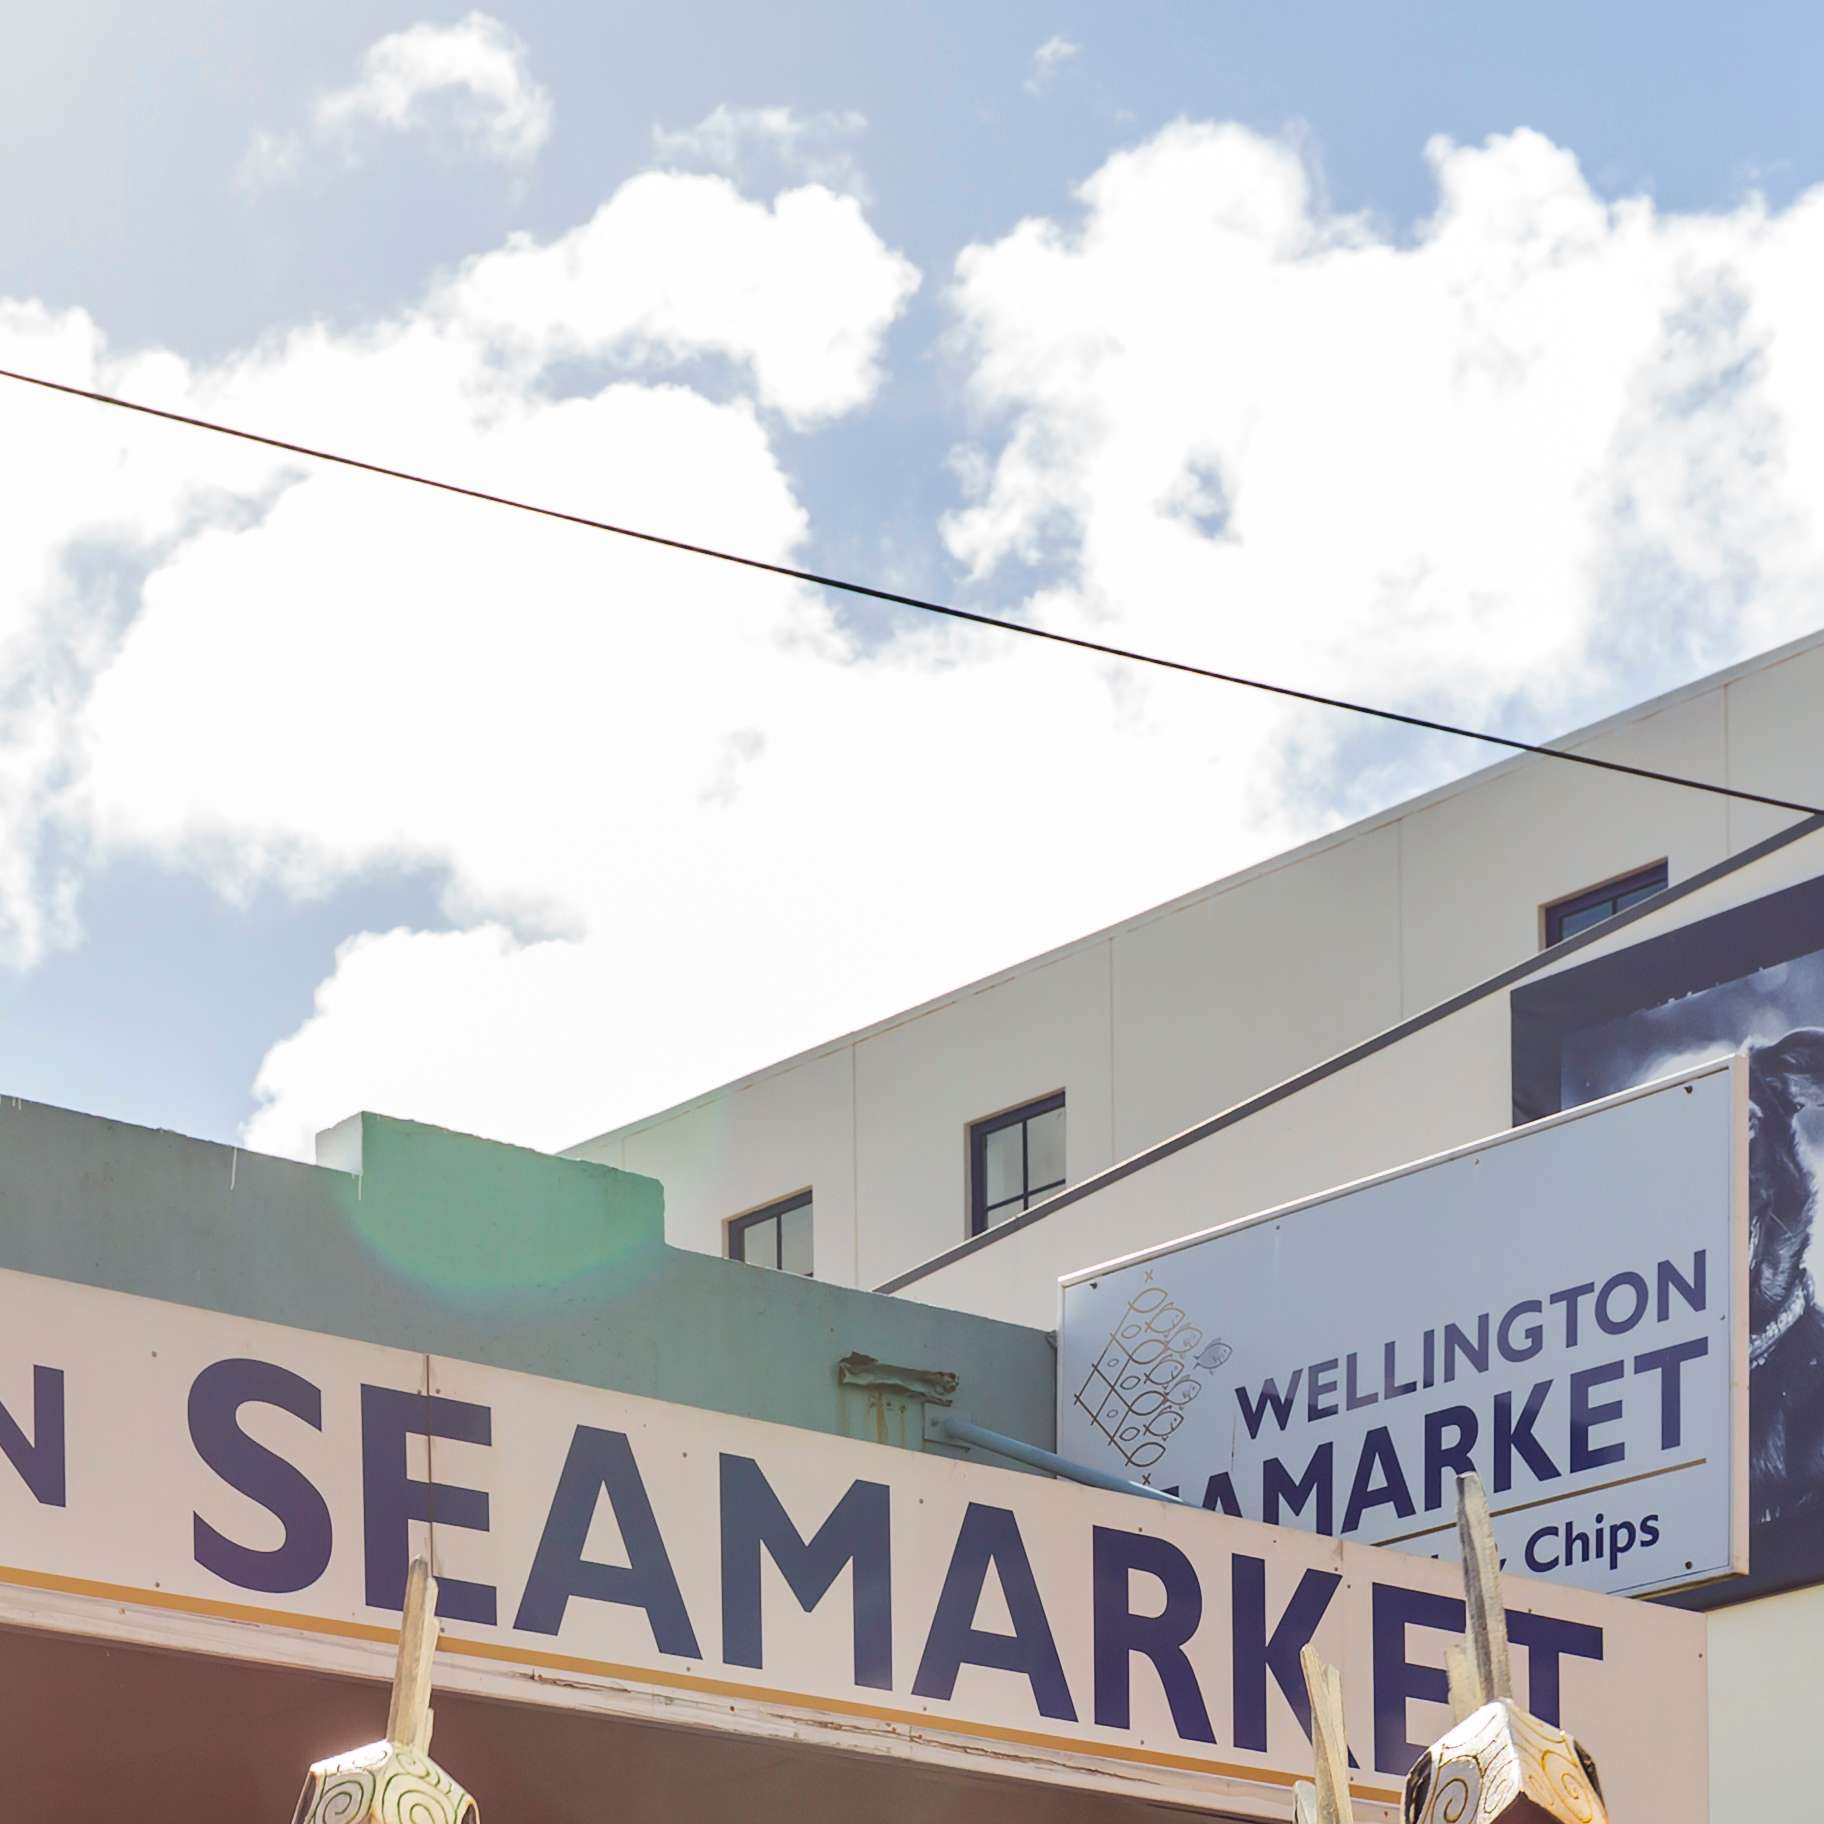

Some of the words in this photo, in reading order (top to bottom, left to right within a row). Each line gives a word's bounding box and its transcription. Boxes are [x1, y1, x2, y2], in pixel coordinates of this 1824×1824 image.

[1160, 1336, 1709, 1537] MARKET
[1234, 1249, 1708, 1440] WELLINGTON
[186, 1357, 1604, 1775] SEAMARKET
[1524, 1513, 1660, 1573] Chips
